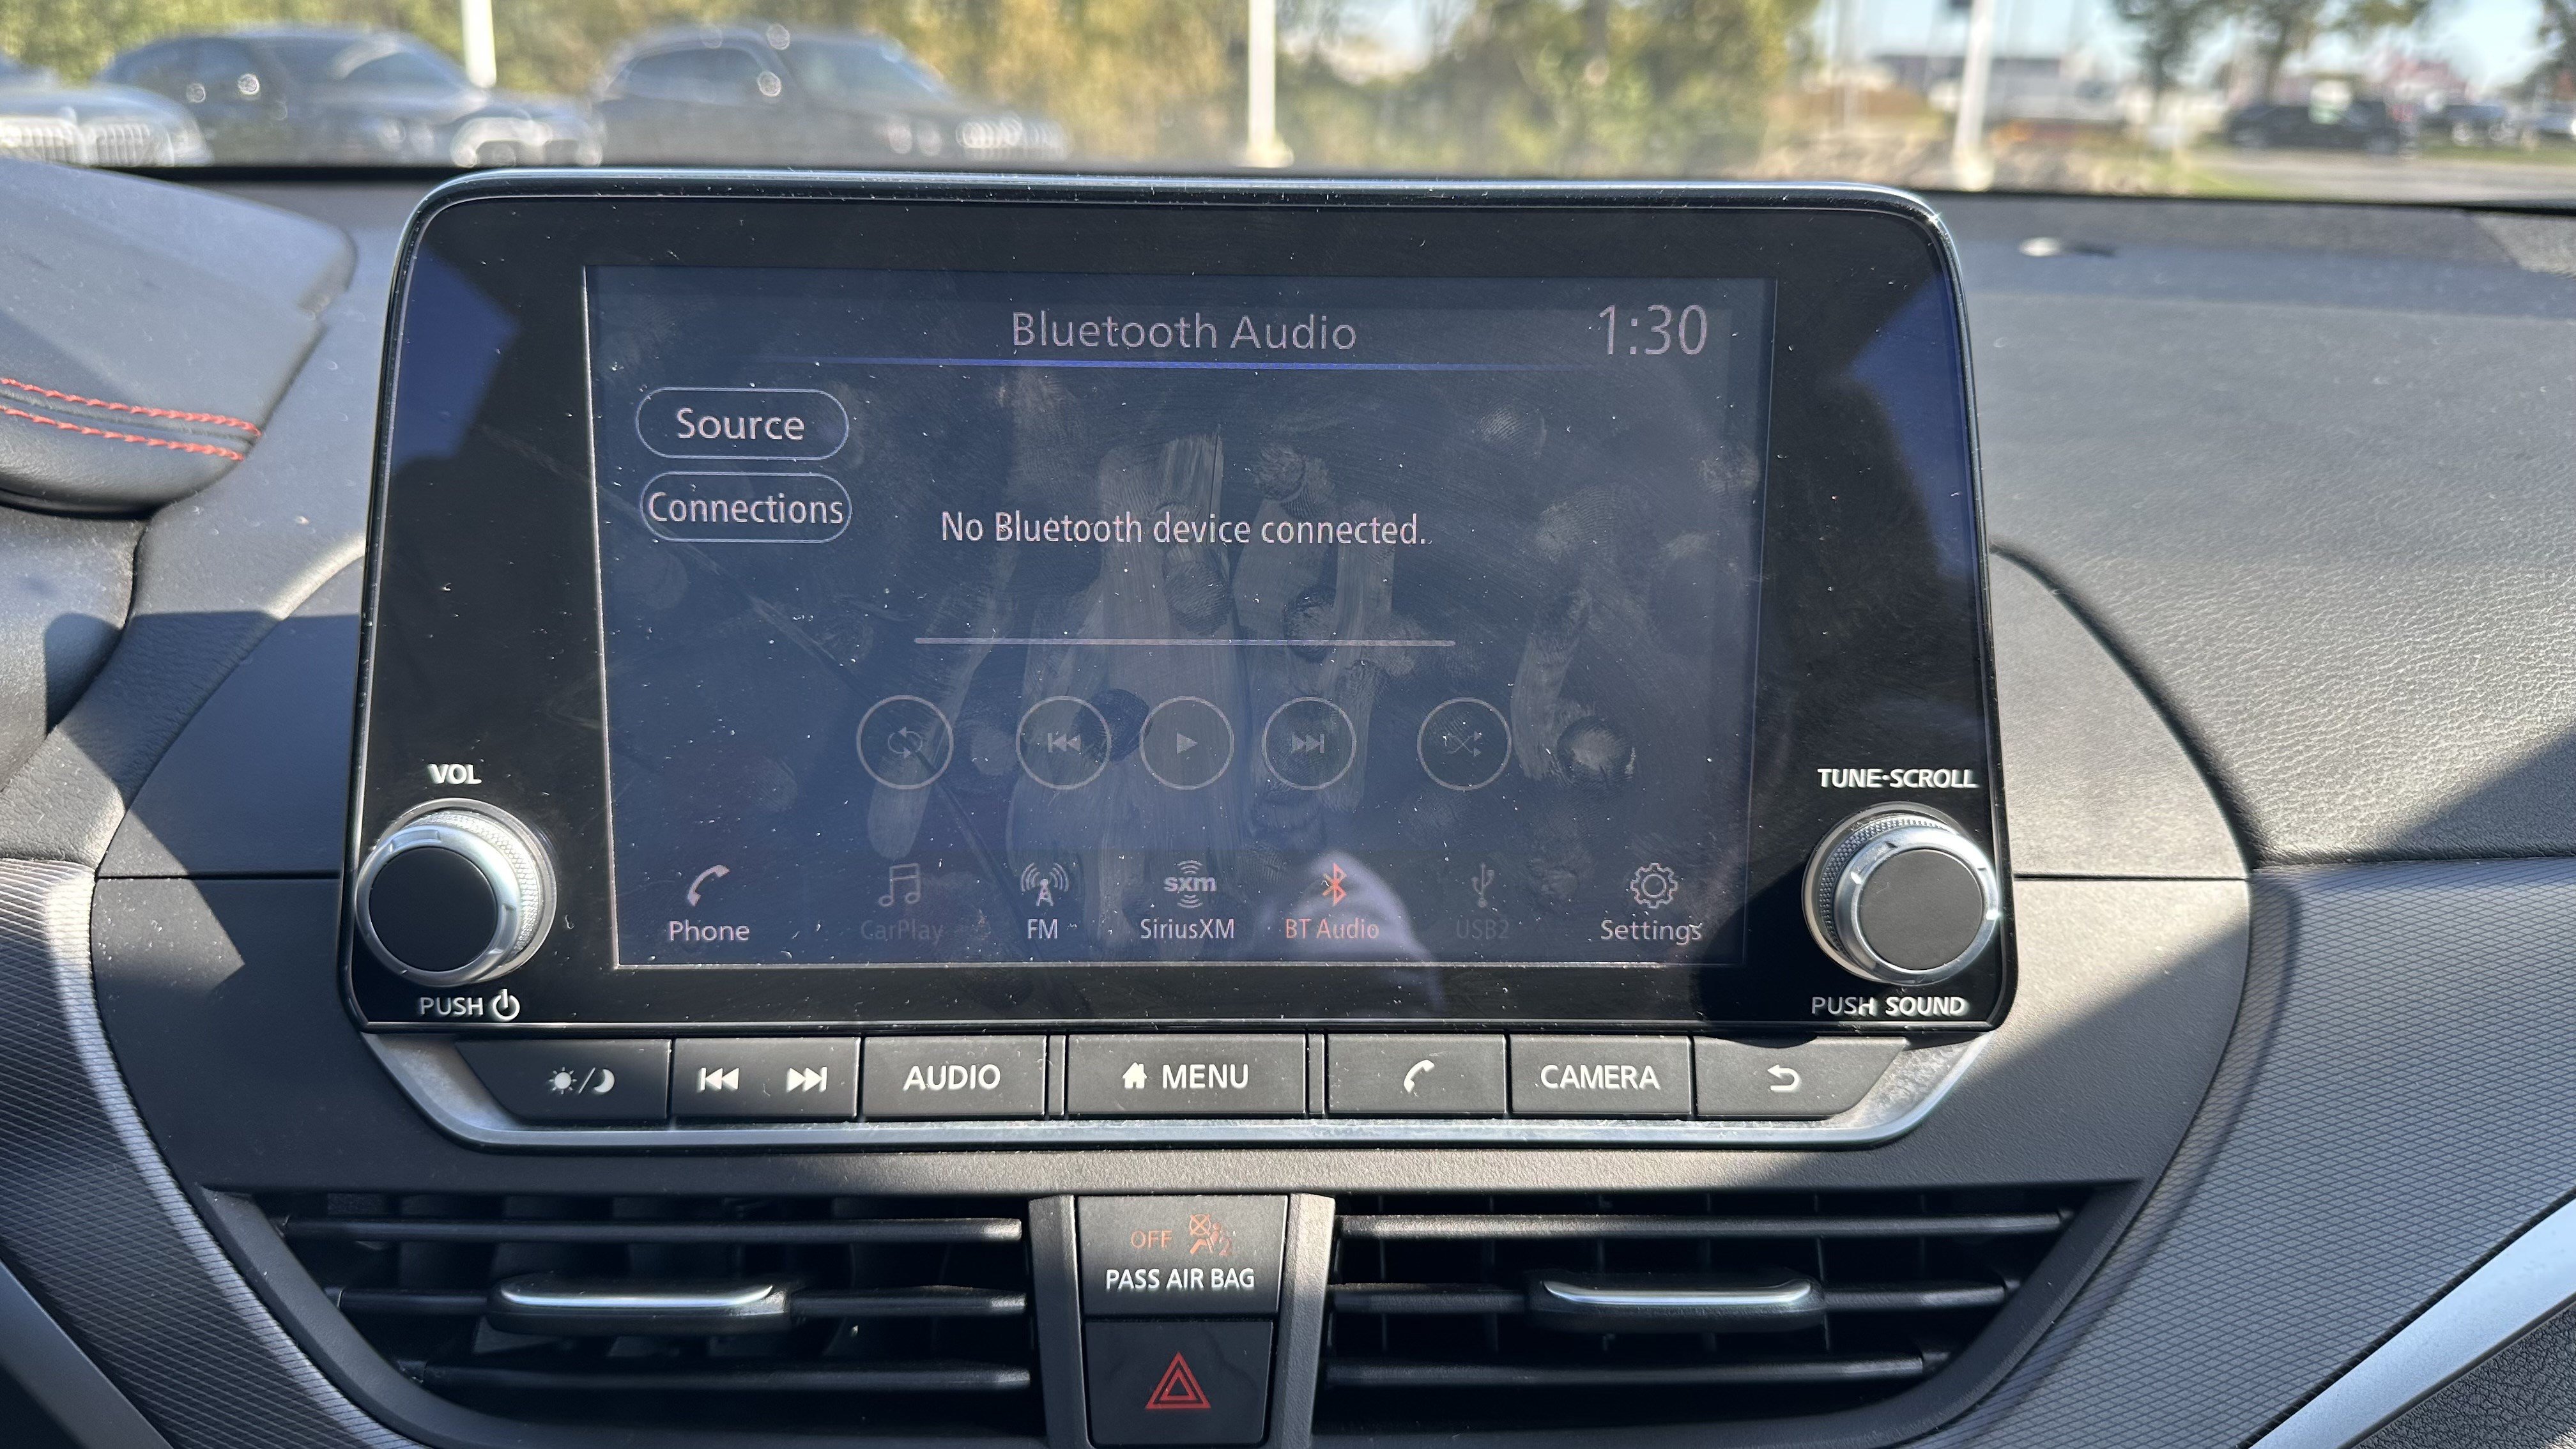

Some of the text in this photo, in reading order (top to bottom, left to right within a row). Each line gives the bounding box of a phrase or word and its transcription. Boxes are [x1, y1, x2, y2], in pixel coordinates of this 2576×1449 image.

[1013, 310, 1356, 350] Bluetooth Audio
[1598, 304, 1707, 355] 1:30
[677, 407, 805, 441] Source
[648, 491, 845, 526] Connections
[942, 510, 1427, 546] No Bluetooth device connected.
[427, 763, 482, 785] VOL
[1163, 877, 1216, 893] sxm
[669, 919, 751, 942] Phone
[860, 919, 944, 944] CarPlay
[1027, 919, 1059, 939] FM
[1140, 918, 1236, 939] SiriusXM
[1285, 917, 1380, 939] BT Audio
[1456, 919, 1510, 940] USB2
[1600, 919, 1703, 946] Settings
[420, 997, 484, 1016] PUSH
[1811, 996, 1968, 1016] PUSH SOUND
[902, 1064, 1002, 1091] AUDIO
[1162, 1064, 1249, 1089] MENU
[1540, 1064, 1661, 1090] CAMERA
[1130, 1230, 1173, 1249] OFF
[1105, 1268, 1255, 1291] PASS AIR BAG
